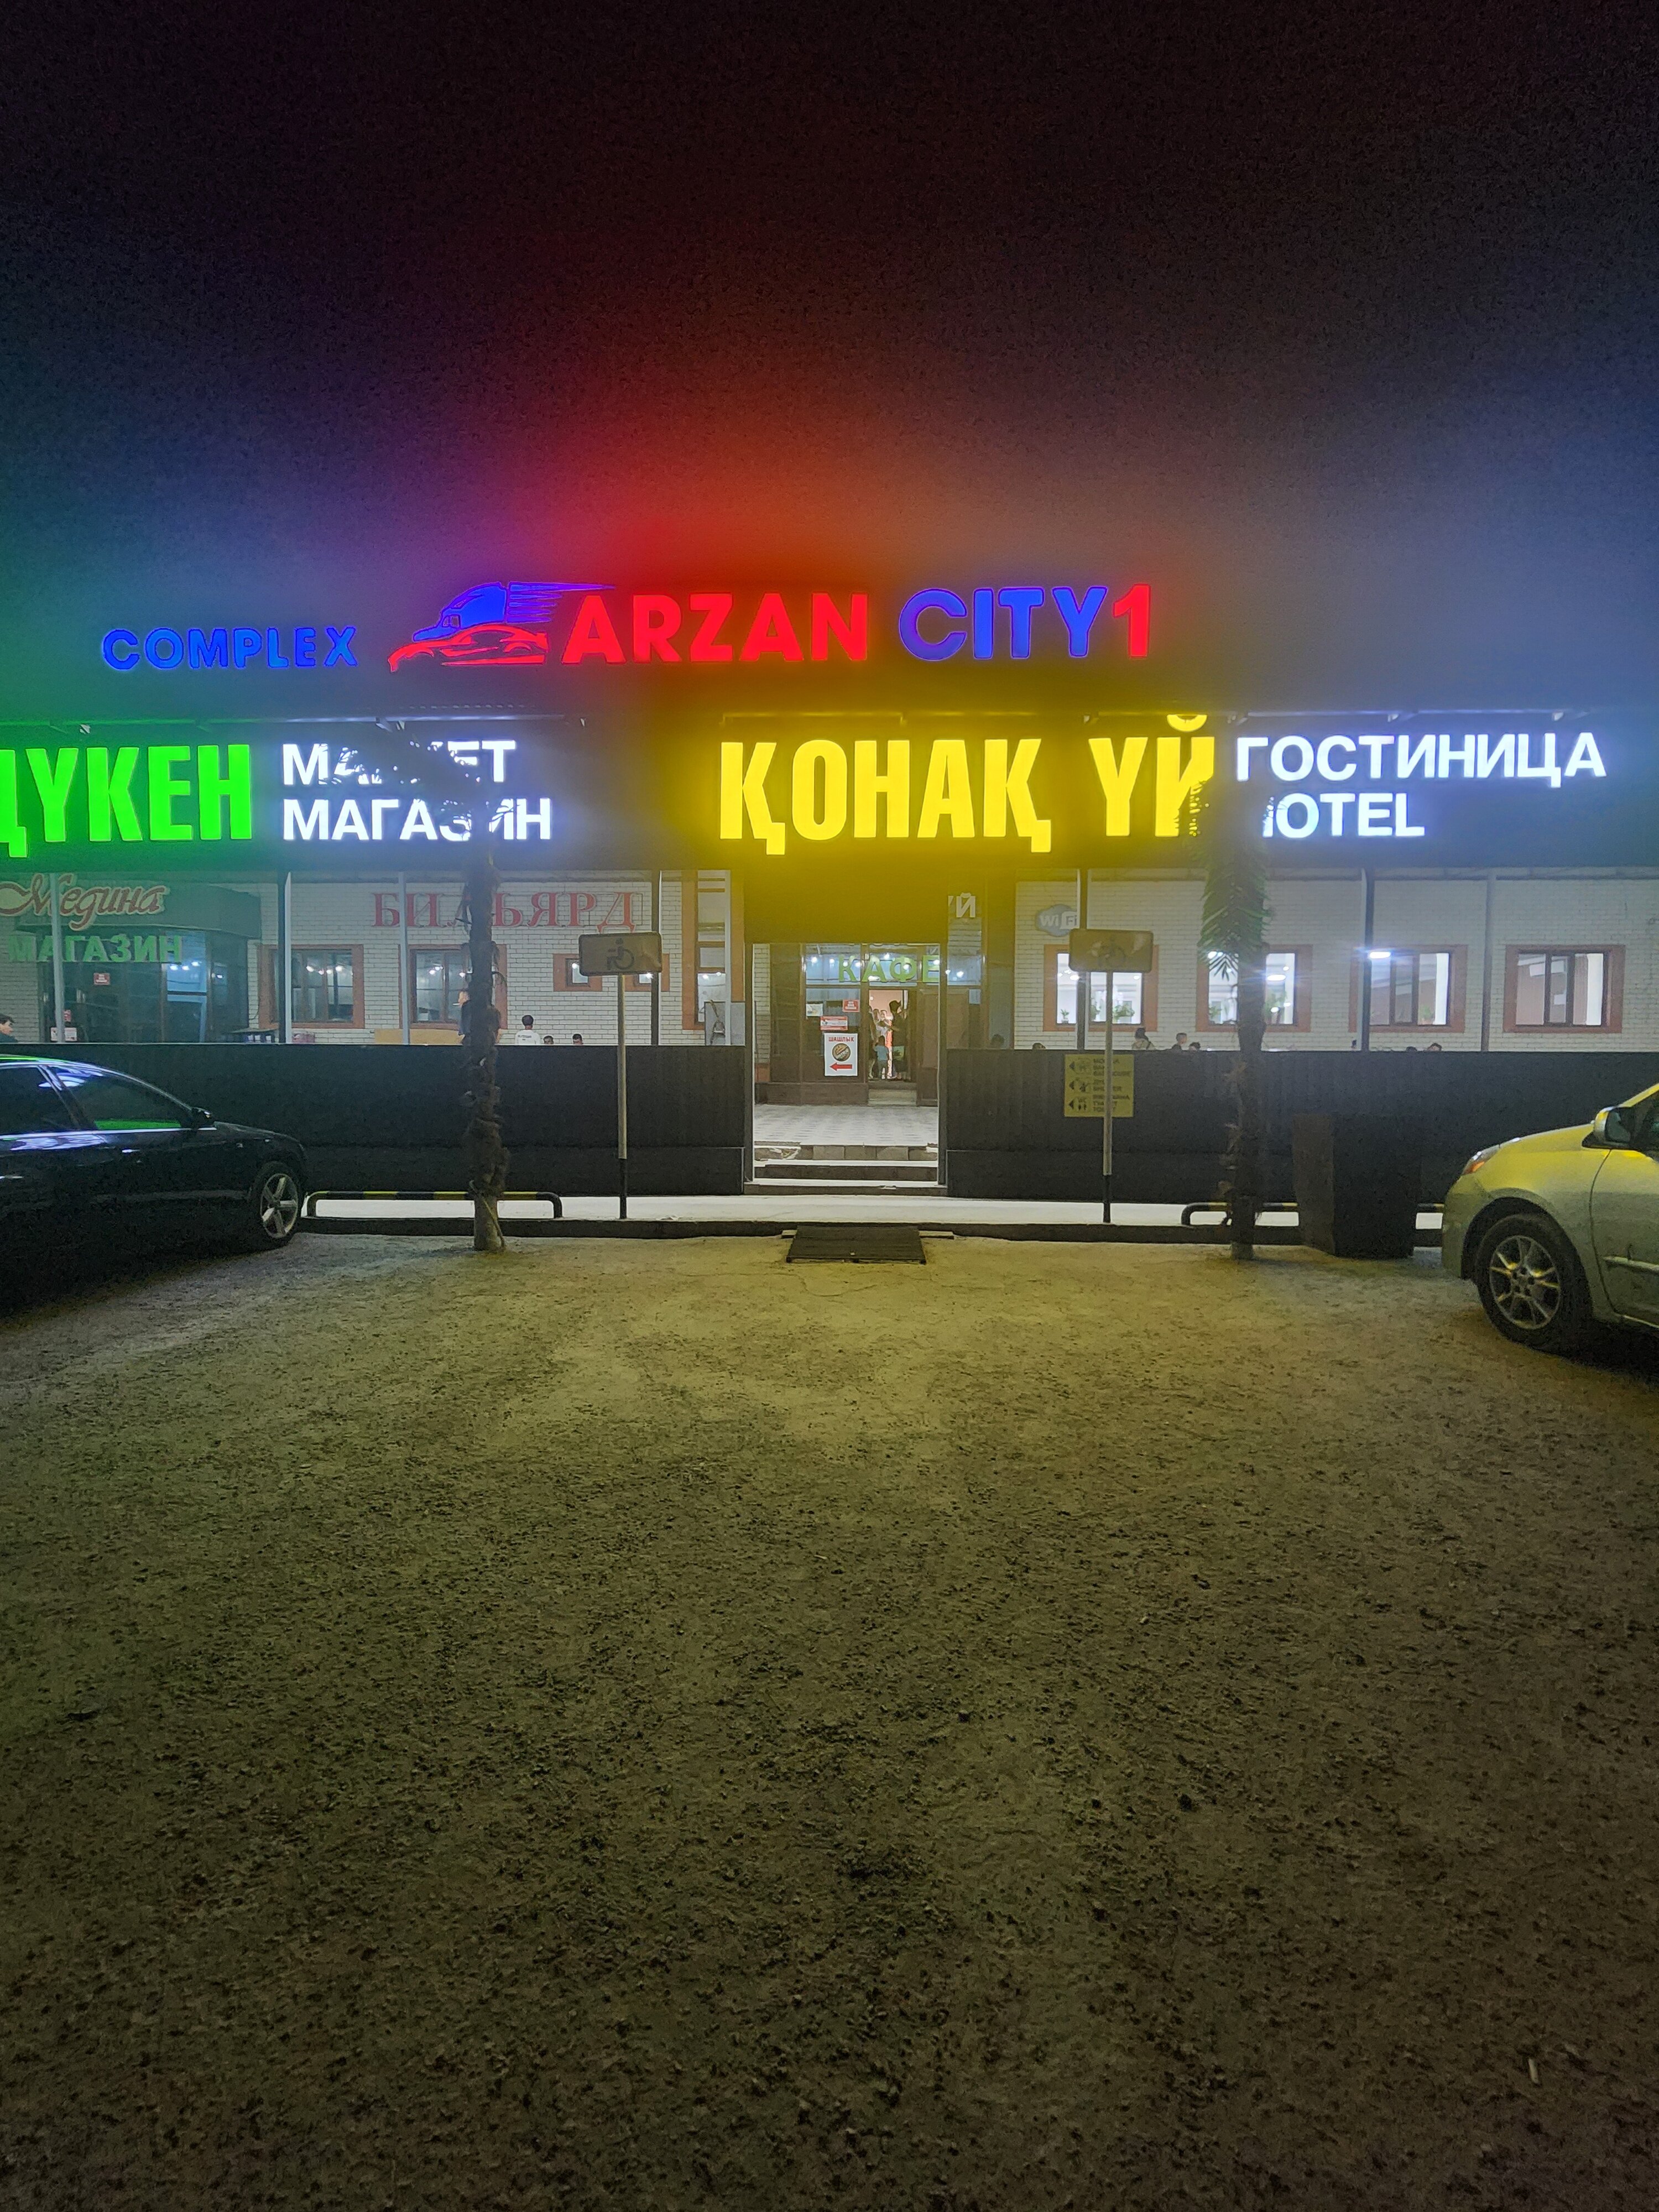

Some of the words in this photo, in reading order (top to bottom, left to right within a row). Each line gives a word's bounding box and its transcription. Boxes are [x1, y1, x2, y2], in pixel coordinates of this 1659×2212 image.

[102, 626, 357, 670] COMPLEX
[561, 592, 868, 664] ARZAN
[1237, 732, 1606, 787] ГОСТИНИЦА
[719, 739, 1052, 855] ҚОНАҚ
[1088, 714, 1215, 837] ҮЙ
[8, 933, 184, 963] МАГАЗИН
[838, 953, 940, 983] КАФЕ
